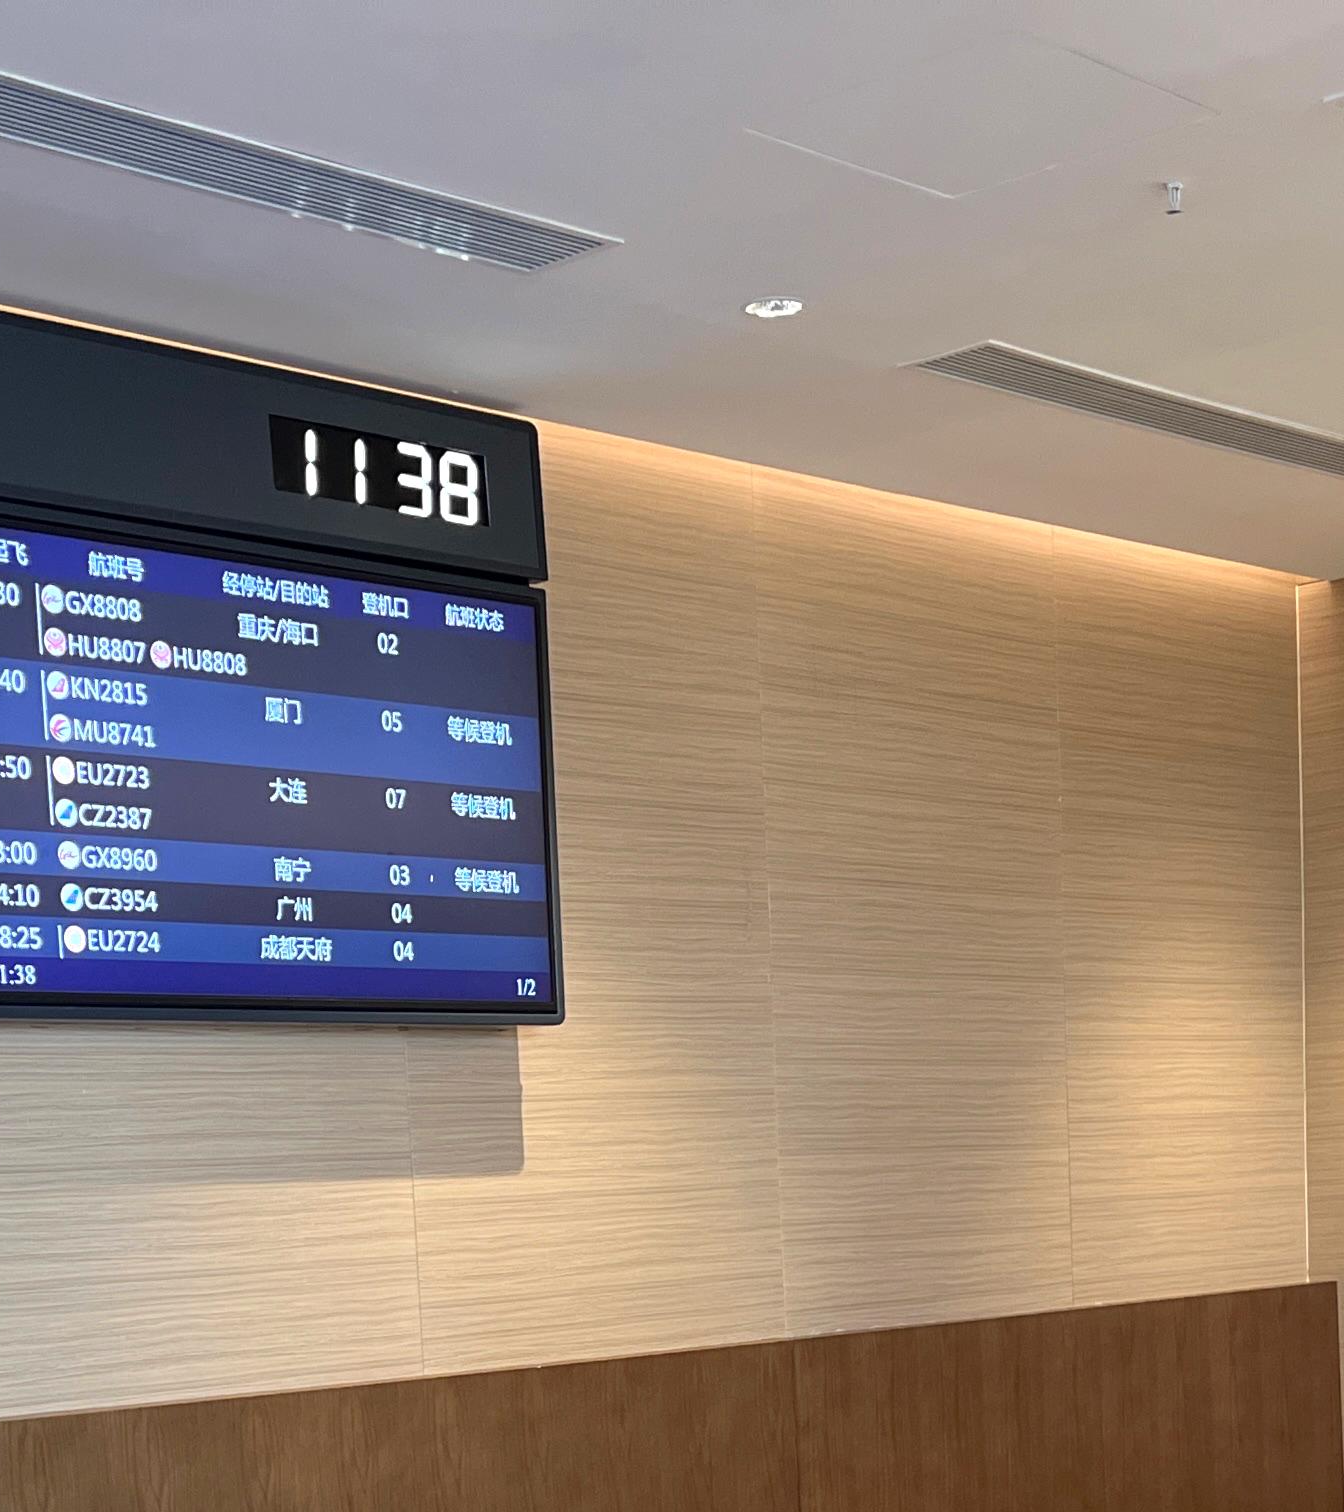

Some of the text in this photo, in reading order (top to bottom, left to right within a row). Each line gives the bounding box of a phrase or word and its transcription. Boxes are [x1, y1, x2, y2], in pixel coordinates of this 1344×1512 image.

[88, 551, 144, 582] 航班号
[222, 571, 329, 608] 经停站/目的站
[362, 593, 409, 618] 登机口
[446, 603, 504, 631] 航班状态
[65, 591, 141, 622] GX8808
[238, 613, 318, 646] 重庆/海口
[378, 633, 398, 655] 02
[68, 634, 246, 675] HU8807 HU8808
[71, 676, 147, 705] KN2815
[265, 697, 301, 724] 厦门
[382, 711, 402, 732] 05
[448, 716, 512, 745] 等候登机
[74, 719, 156, 747] MU8741
[74, 762, 149, 789] EU2723
[269, 777, 307, 804] 大连
[386, 788, 406, 808] 07
[451, 792, 516, 820] 等候登机
[79, 804, 152, 829] CZ2387
[80, 846, 157, 871] GX8960
[274, 856, 311, 882] 南宁
[390, 865, 410, 885] 03
[455, 867, 519, 893] 等候登机
[82, 888, 158, 912] CZ3954
[277, 896, 312, 921] 广州
[392, 903, 412, 923] 04
[85, 929, 160, 952] EU2724
[261, 935, 332, 961] 成都天府
[394, 941, 414, 961] 04
[517, 979, 536, 995] 1/2
